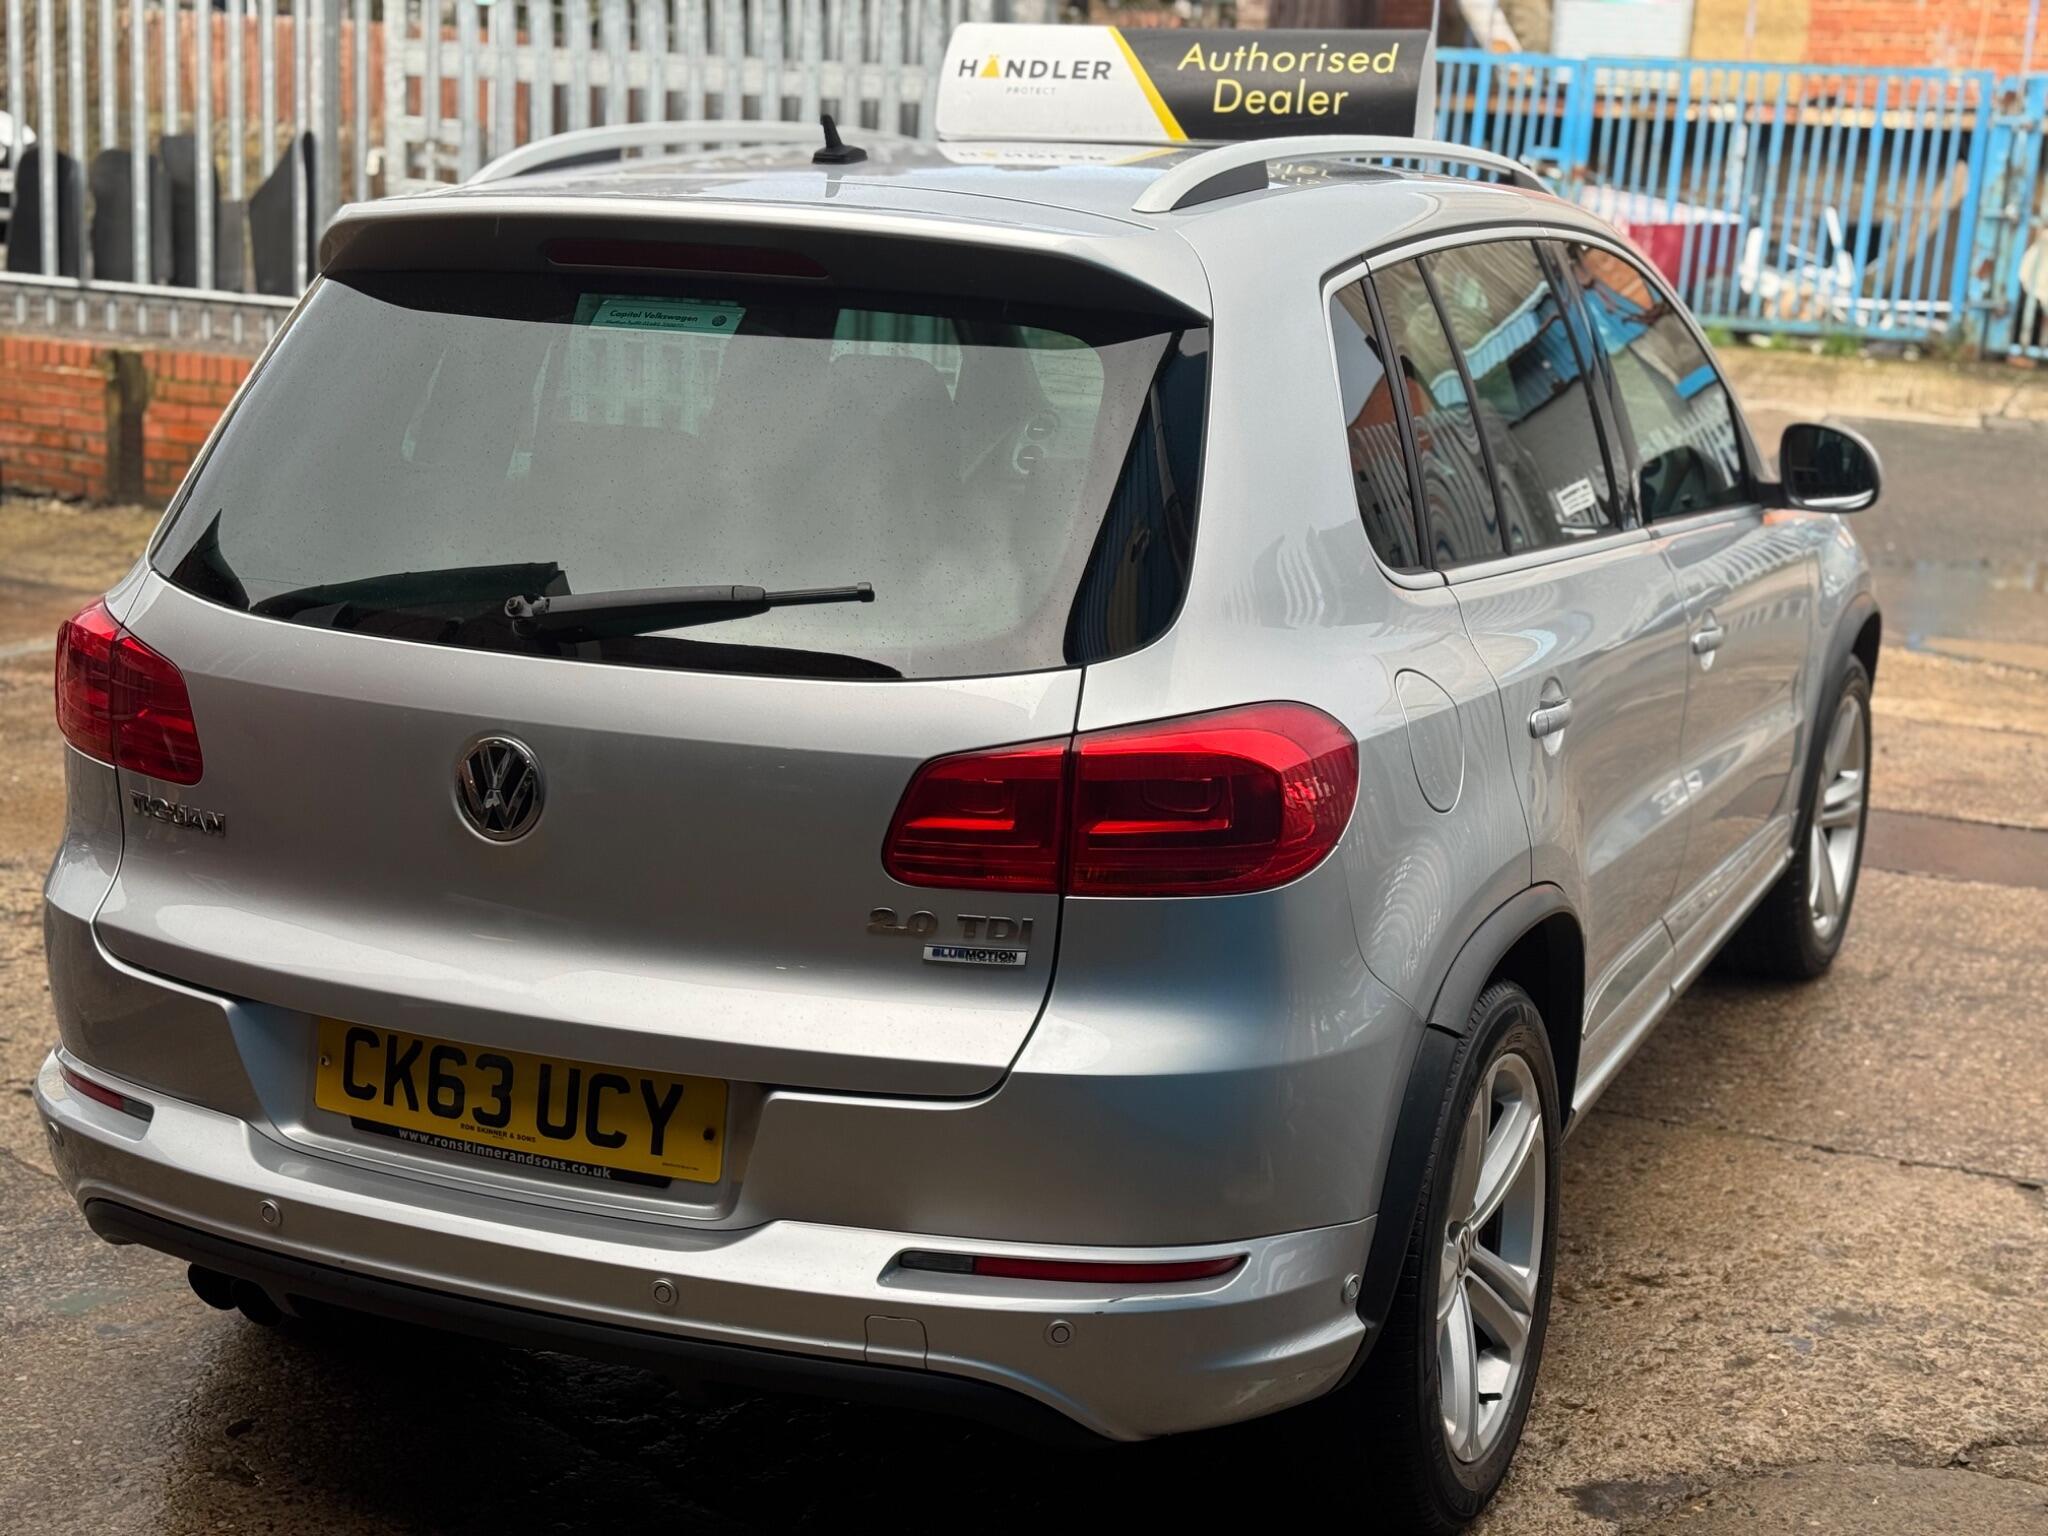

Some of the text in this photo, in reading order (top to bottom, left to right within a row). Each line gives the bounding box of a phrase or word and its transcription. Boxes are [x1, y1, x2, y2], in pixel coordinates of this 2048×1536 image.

[1177, 42, 1399, 73] Authorised
[1005, 86, 1057, 95] PROTECT
[1213, 78, 1349, 115] Dealer
[644, 312, 698, 322] Volkswagen
[866, 907, 1034, 943] 2.0 TDI
[932, 947, 1018, 961] BLUEMOTION
[342, 1026, 684, 1157] CK63 UCY
[460, 1123, 476, 1132] RON
[477, 1125, 508, 1138] SKINNER
[517, 1134, 537, 1142] SONS
[398, 1129, 612, 1179] www.ronskinnerandsons.co.uk
